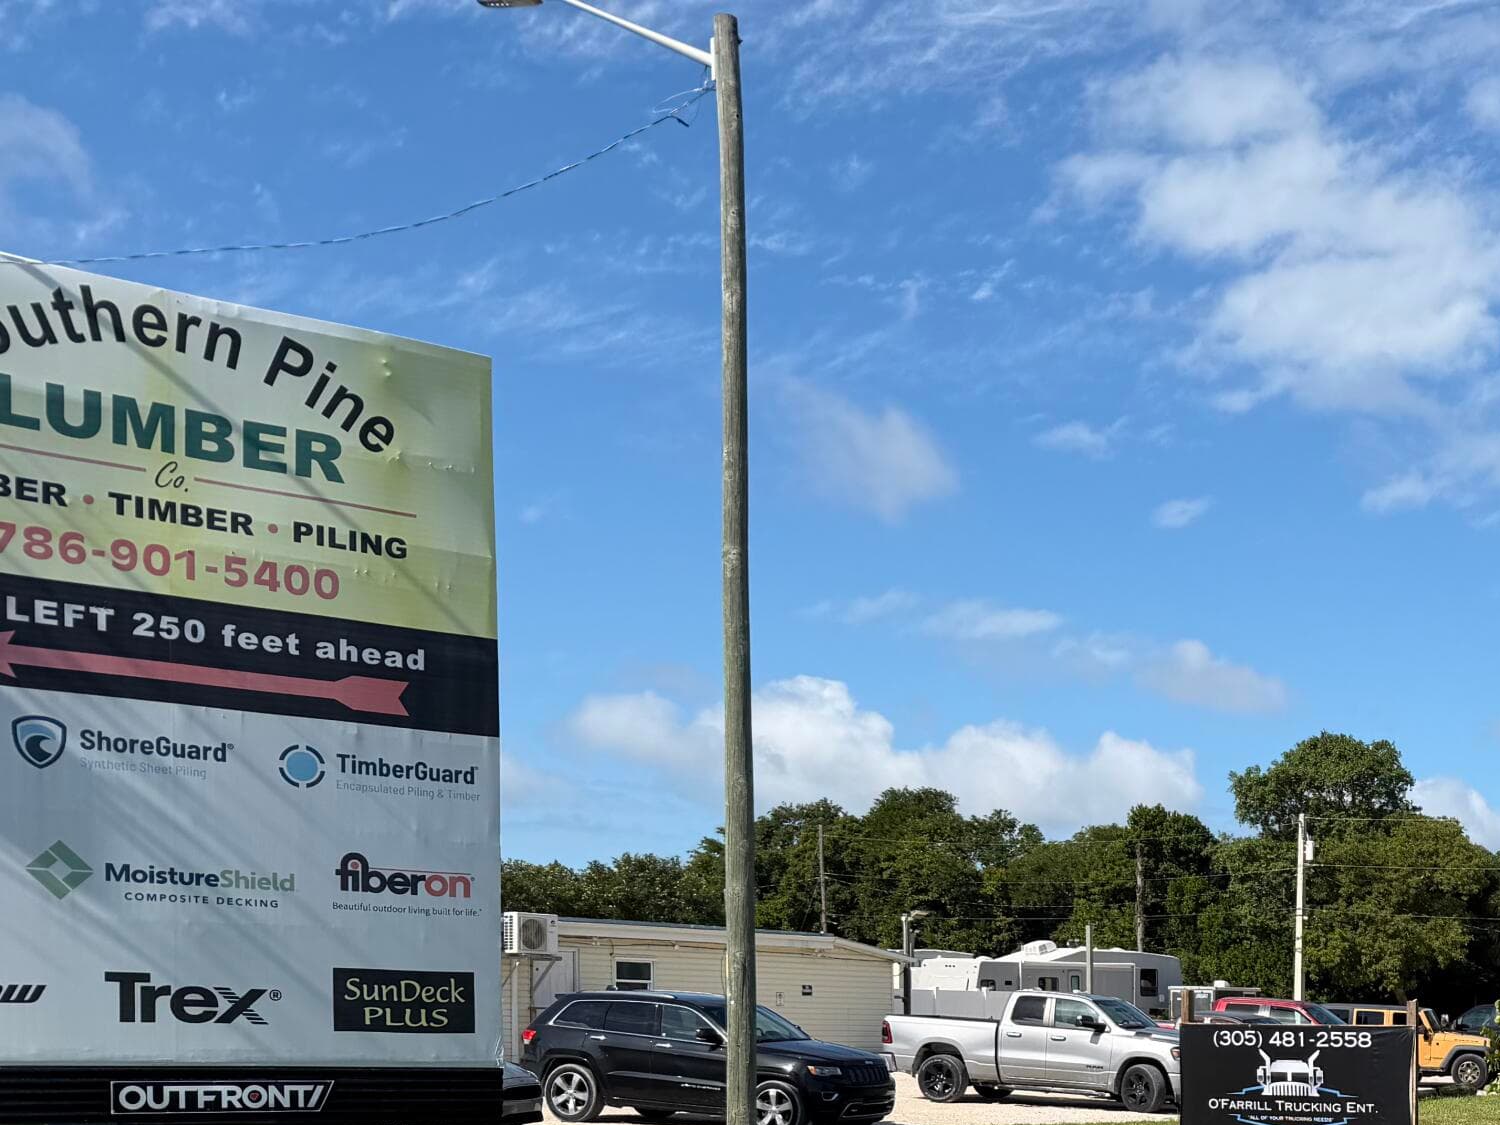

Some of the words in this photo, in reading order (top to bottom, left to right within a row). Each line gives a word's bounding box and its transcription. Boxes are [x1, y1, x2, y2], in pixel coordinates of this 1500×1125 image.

[0, 284, 242, 370] uthern
[263, 336, 395, 453] Pine
[0, 372, 345, 484] LUMBER
[155, 461, 190, 492] Co.
[108, 491, 254, 536] TIMBER
[293, 521, 407, 559] PILING
[0, 521, 340, 599] 786-901-5400
[6, 595, 115, 631] LEFT
[132, 612, 205, 643] 250
[222, 623, 300, 656] feet
[316, 639, 426, 671] ahead
[79, 757, 137, 772] Synthetic
[139, 762, 172, 775] Sheet
[175, 765, 207, 779] Piling
[336, 780, 405, 796] Encapsulated
[407, 786, 434, 799] Piling
[437, 789, 444, 798] &
[448, 789, 480, 801] Timber
[105, 862, 295, 892] MoistureShield
[124, 891, 209, 904] COMPOSITE
[217, 896, 279, 908] DECKING
[332, 902, 371, 912] Beautiful
[373, 904, 406, 914] outdoor
[408, 905, 430, 917] living
[432, 907, 450, 916] built
[452, 907, 463, 917] for
[344, 977, 465, 1004] SunDeck
[364, 1006, 448, 1027] PLUS
[1213, 1030, 1263, 1048] (305)
[1269, 1031, 1372, 1048] 481-2558
[1208, 1098, 1272, 1111] O'FARRILL
[1277, 1100, 1341, 1113] TRUCKING
[1346, 1102, 1379, 1114] ENT.
